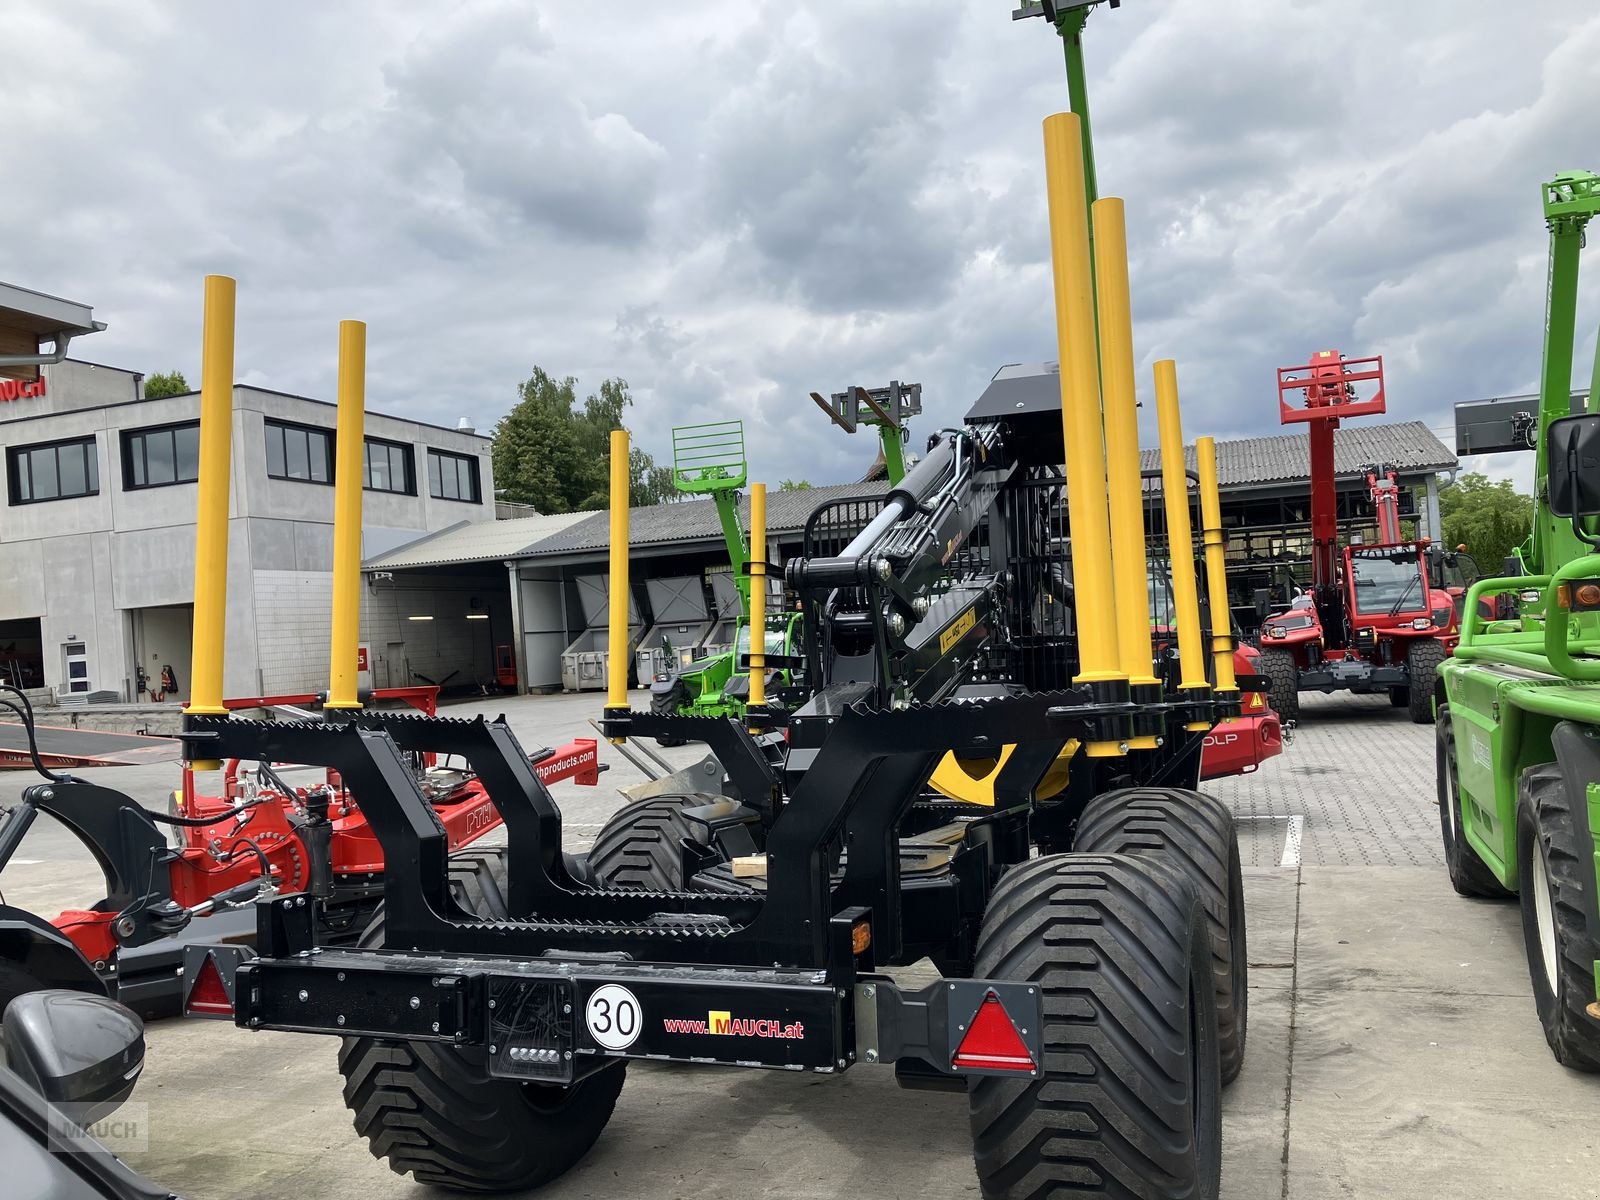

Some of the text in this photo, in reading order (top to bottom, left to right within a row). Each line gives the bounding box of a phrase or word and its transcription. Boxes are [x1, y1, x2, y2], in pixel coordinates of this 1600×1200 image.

[466, 802, 491, 834] PTH
[593, 998, 635, 1036] 30
[664, 1017, 804, 1039] www.MAUCH.at
